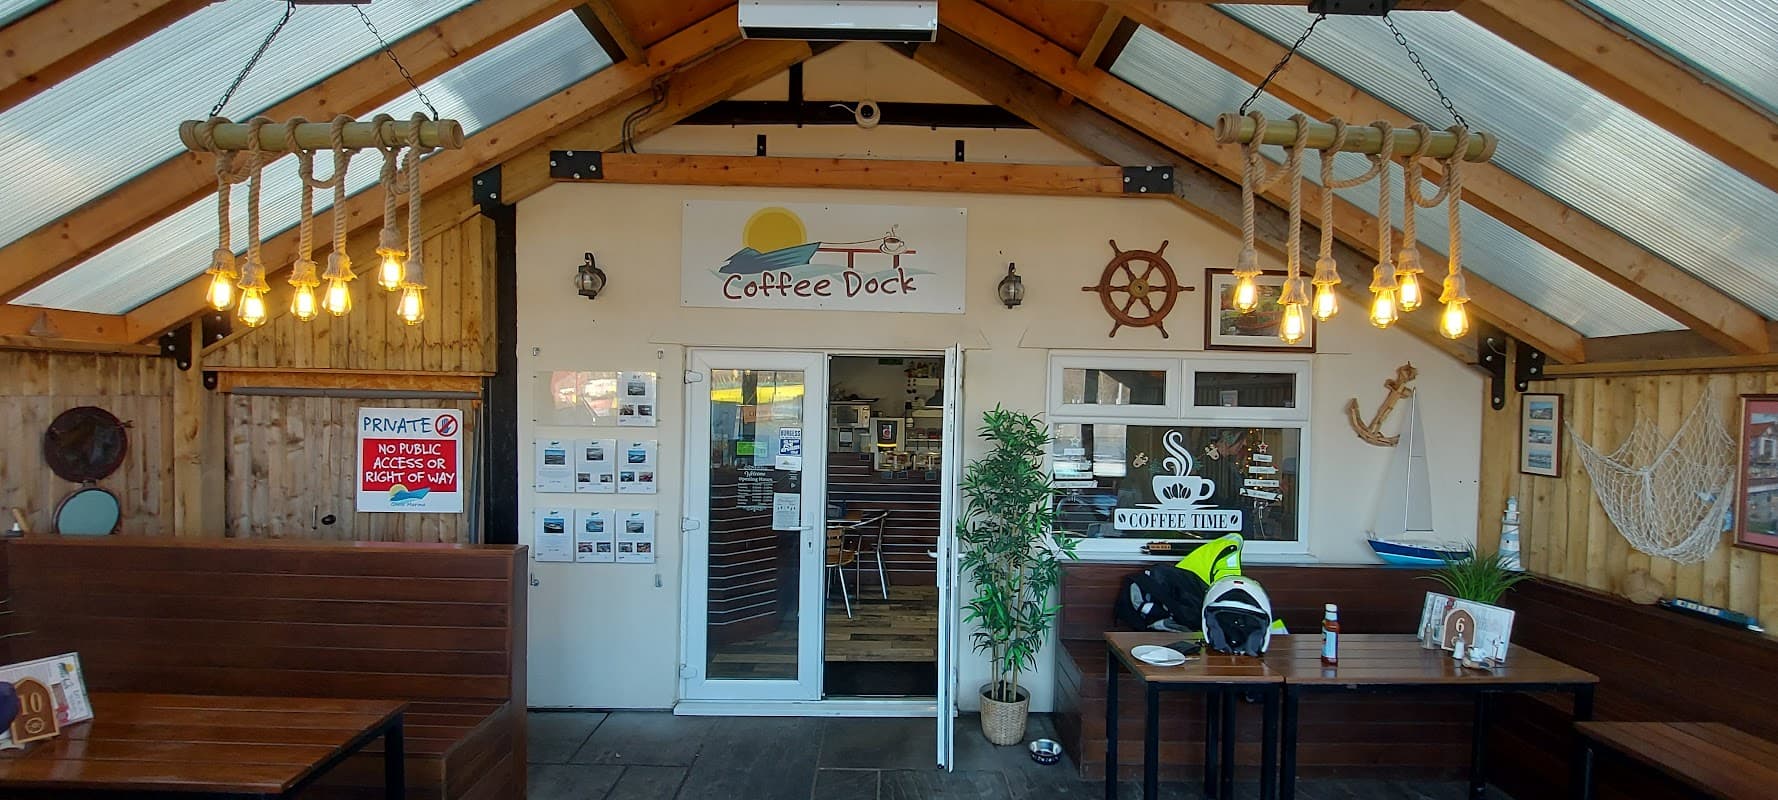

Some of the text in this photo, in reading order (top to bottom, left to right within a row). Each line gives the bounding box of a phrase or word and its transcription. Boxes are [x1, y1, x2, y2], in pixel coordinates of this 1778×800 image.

[723, 267, 917, 299] Coffee Dock
[364, 417, 431, 433] PRIVATE
[378, 443, 441, 455] NO PUBLIC
[373, 457, 446, 469] ACCESS OR
[365, 471, 455, 484] RIGHT OF WAY
[1129, 513, 1228, 529] COFFEE TIME
[1456, 618, 1465, 632] 6
[19, 692, 42, 715] 10
